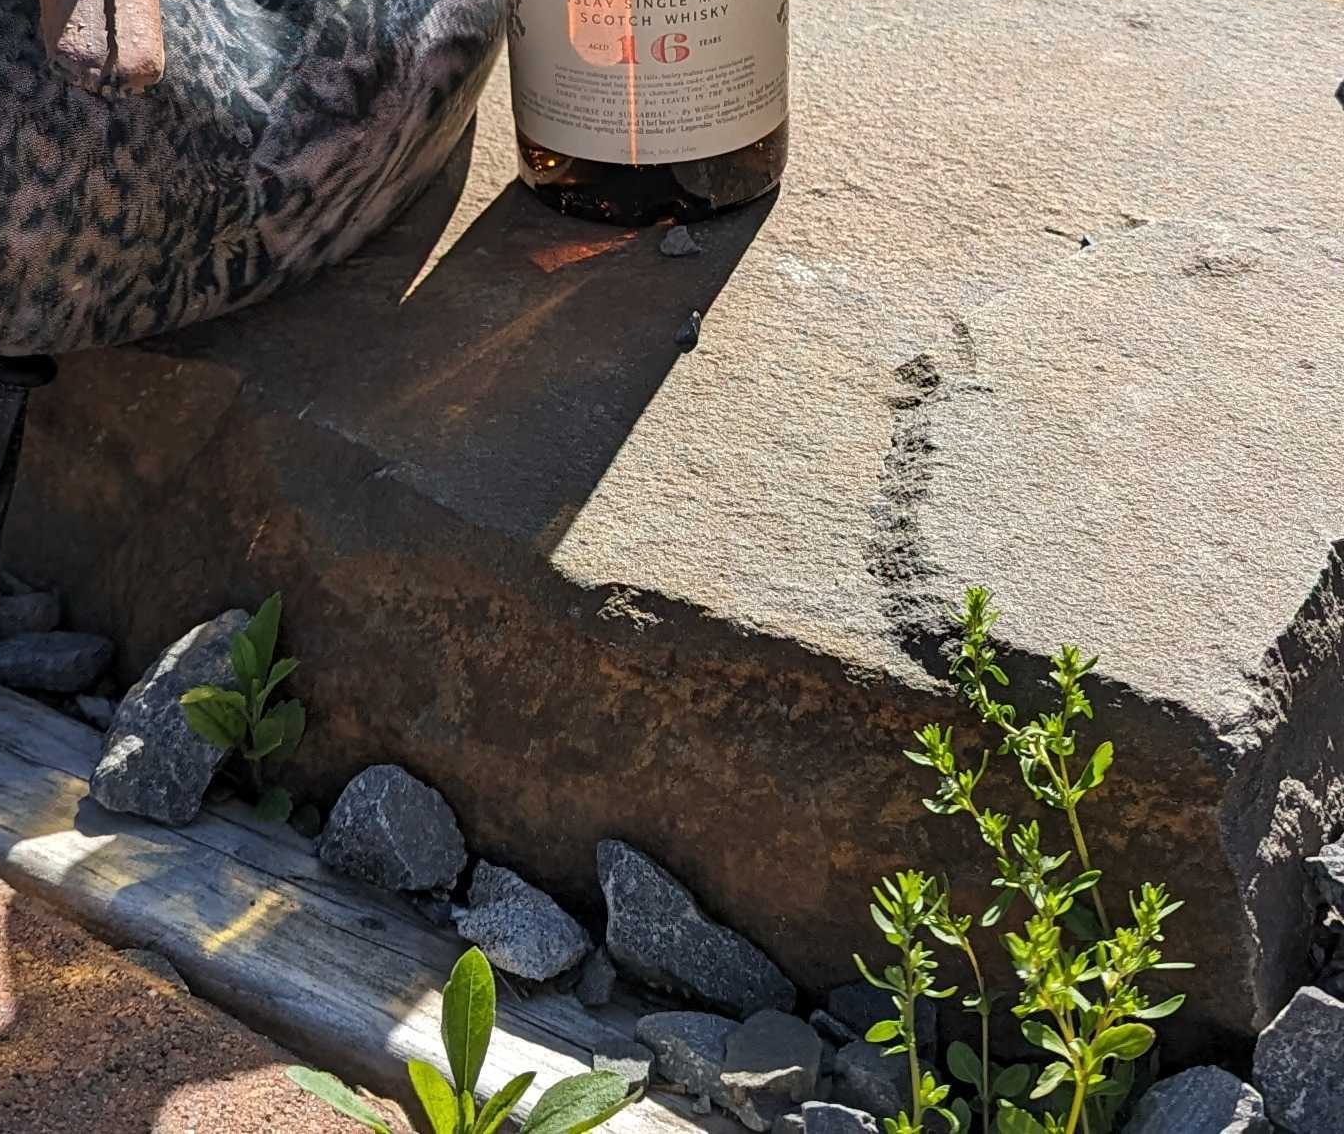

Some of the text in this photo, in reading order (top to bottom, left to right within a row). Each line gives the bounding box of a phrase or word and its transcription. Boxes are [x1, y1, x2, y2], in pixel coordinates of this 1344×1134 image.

[580, 3, 730, 27] SCOTCH WHISKY
[588, 43, 611, 52] AGED
[616, 31, 691, 65] 16
